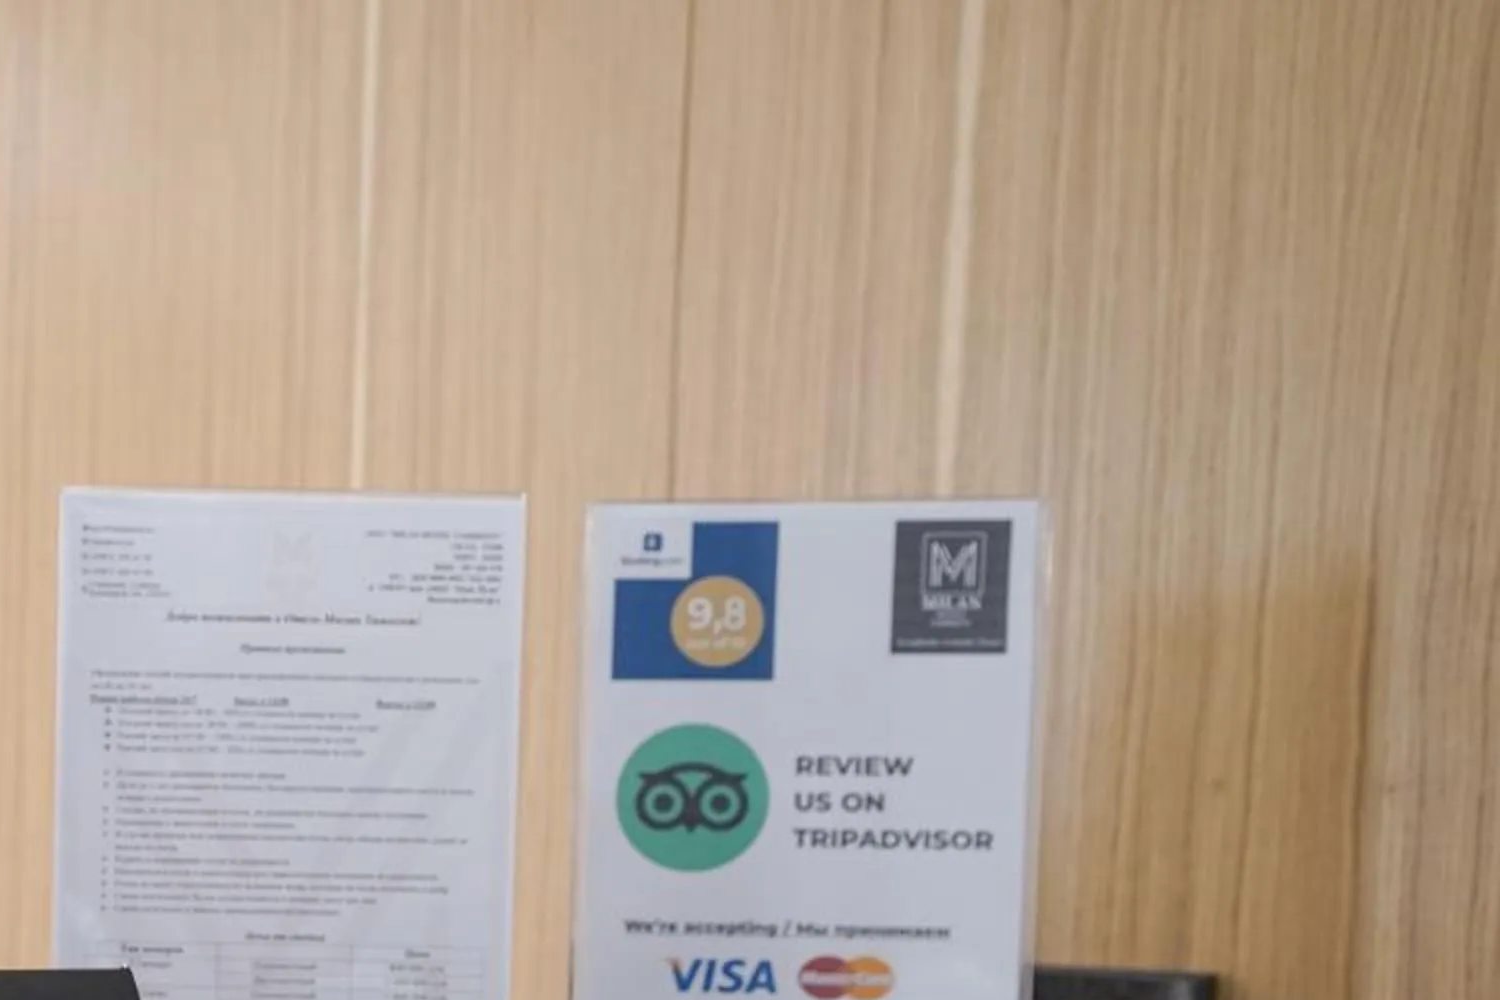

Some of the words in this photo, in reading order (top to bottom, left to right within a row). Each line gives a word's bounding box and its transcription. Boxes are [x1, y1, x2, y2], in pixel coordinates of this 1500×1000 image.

[686, 596, 747, 635] 9,8
[795, 756, 915, 777] REVIEW
[794, 793, 832, 813] US
[840, 793, 886, 813] ON
[793, 829, 995, 851] TRIPADVISOR
[684, 920, 779, 938] accepting
[665, 957, 779, 995] VISA
